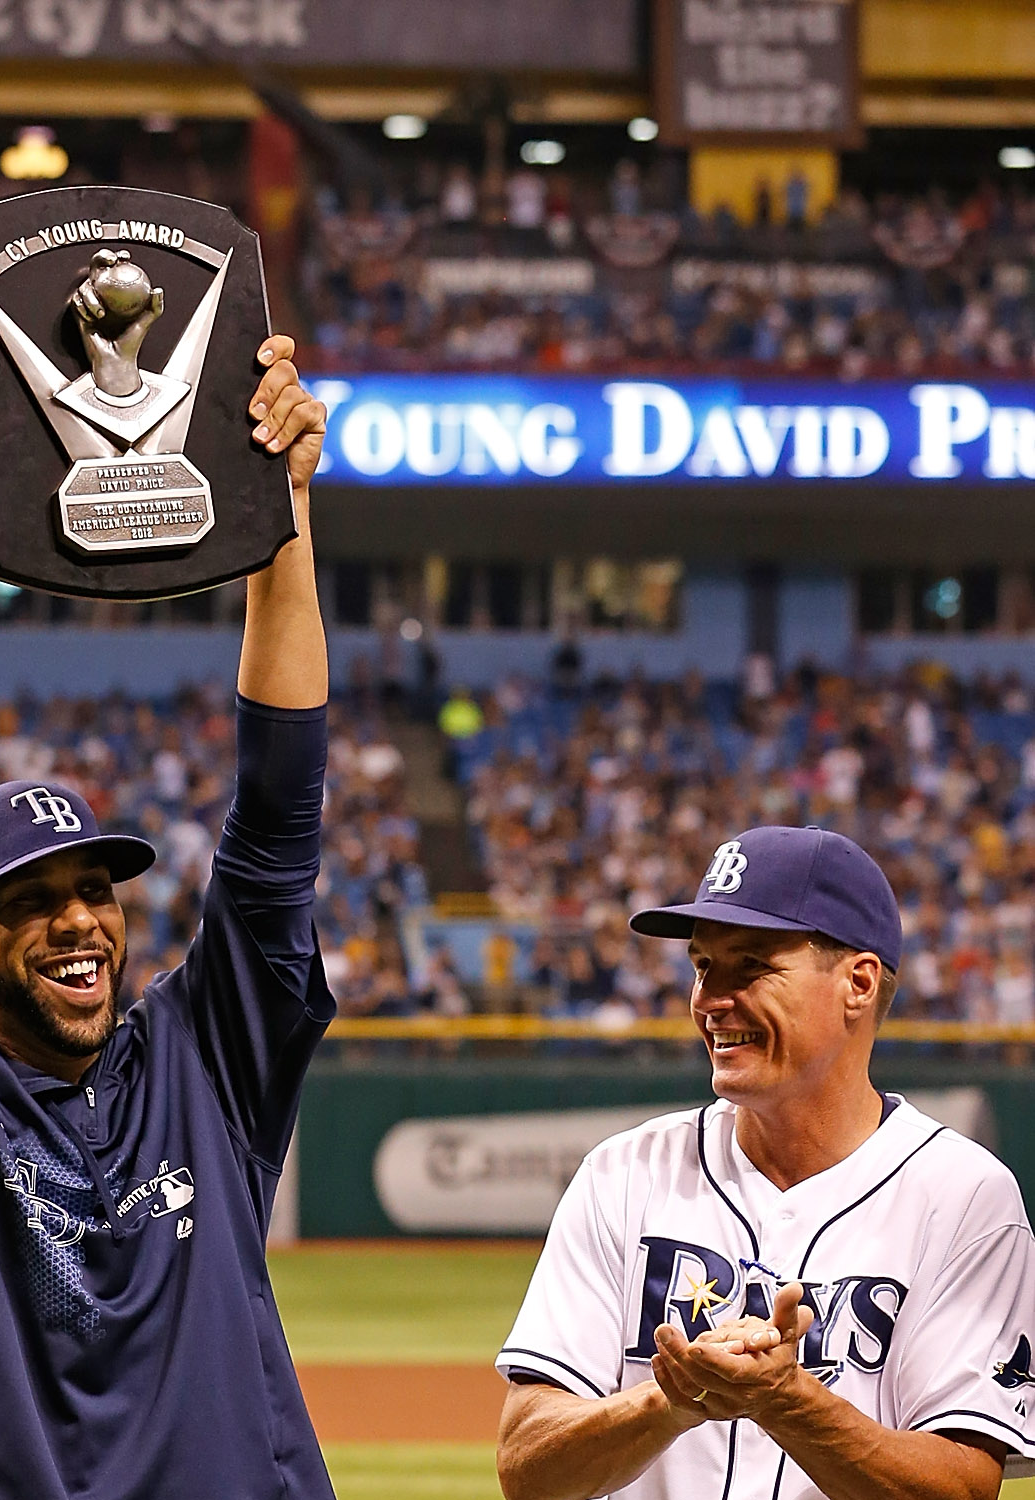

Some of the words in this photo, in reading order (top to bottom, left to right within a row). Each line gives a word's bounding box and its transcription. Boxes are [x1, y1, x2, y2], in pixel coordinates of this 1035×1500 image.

[4, 236, 32, 262] CY
[37, 219, 104, 249] YOUNG
[118, 220, 185, 249] AWARD
[97, 466, 150, 479] PRESENTED
[152, 465, 165, 475] TO
[100, 480, 131, 492] DAVID
[136, 478, 164, 490] PRICE
[94, 503, 115, 516] THE
[118, 500, 184, 514] OUTSTANDING
[72, 517, 120, 531] AMERICAN
[121, 514, 161, 527] LEAGUE
[163, 511, 204, 525] PITCHER
[131, 526, 154, 539] 2012
[10, 787, 83, 833] TB
[705, 840, 748, 894] TB
